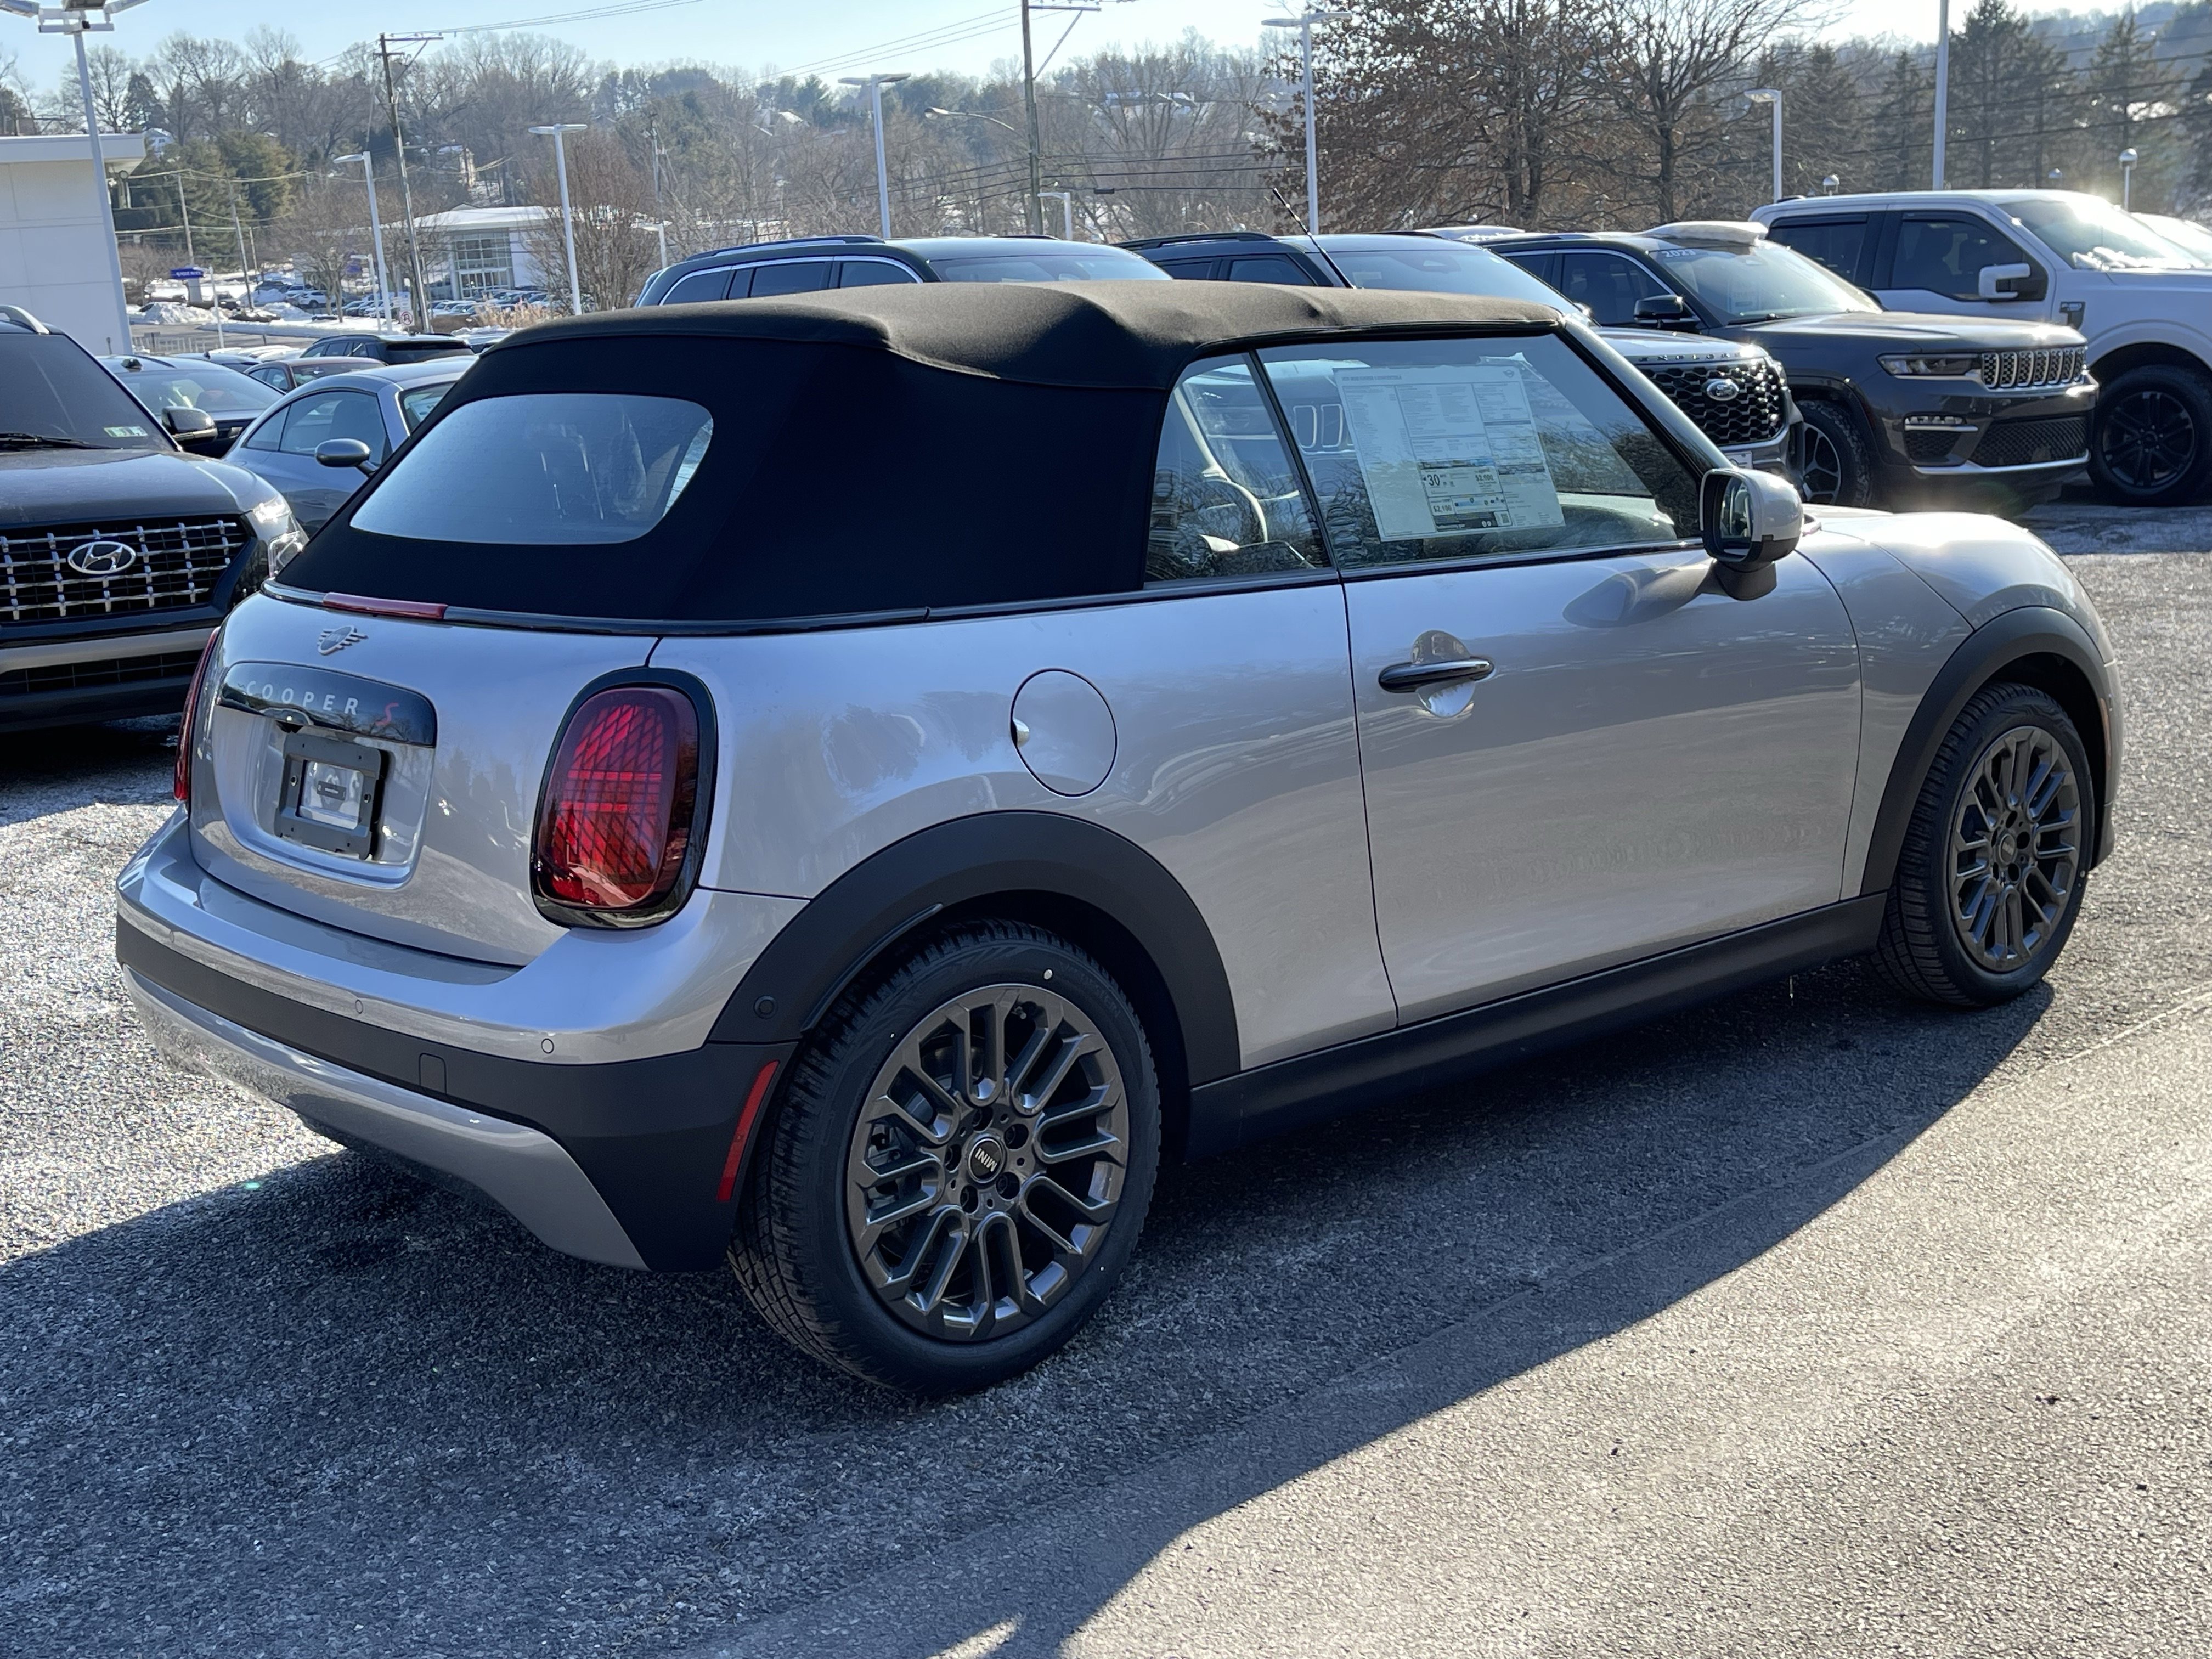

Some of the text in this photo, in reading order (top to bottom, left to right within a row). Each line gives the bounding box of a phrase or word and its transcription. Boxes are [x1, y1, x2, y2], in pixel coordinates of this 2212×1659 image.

[1427, 474, 1440, 486] 30
[246, 680, 399, 726] COOPER S
[975, 1148, 997, 1172] MINI
